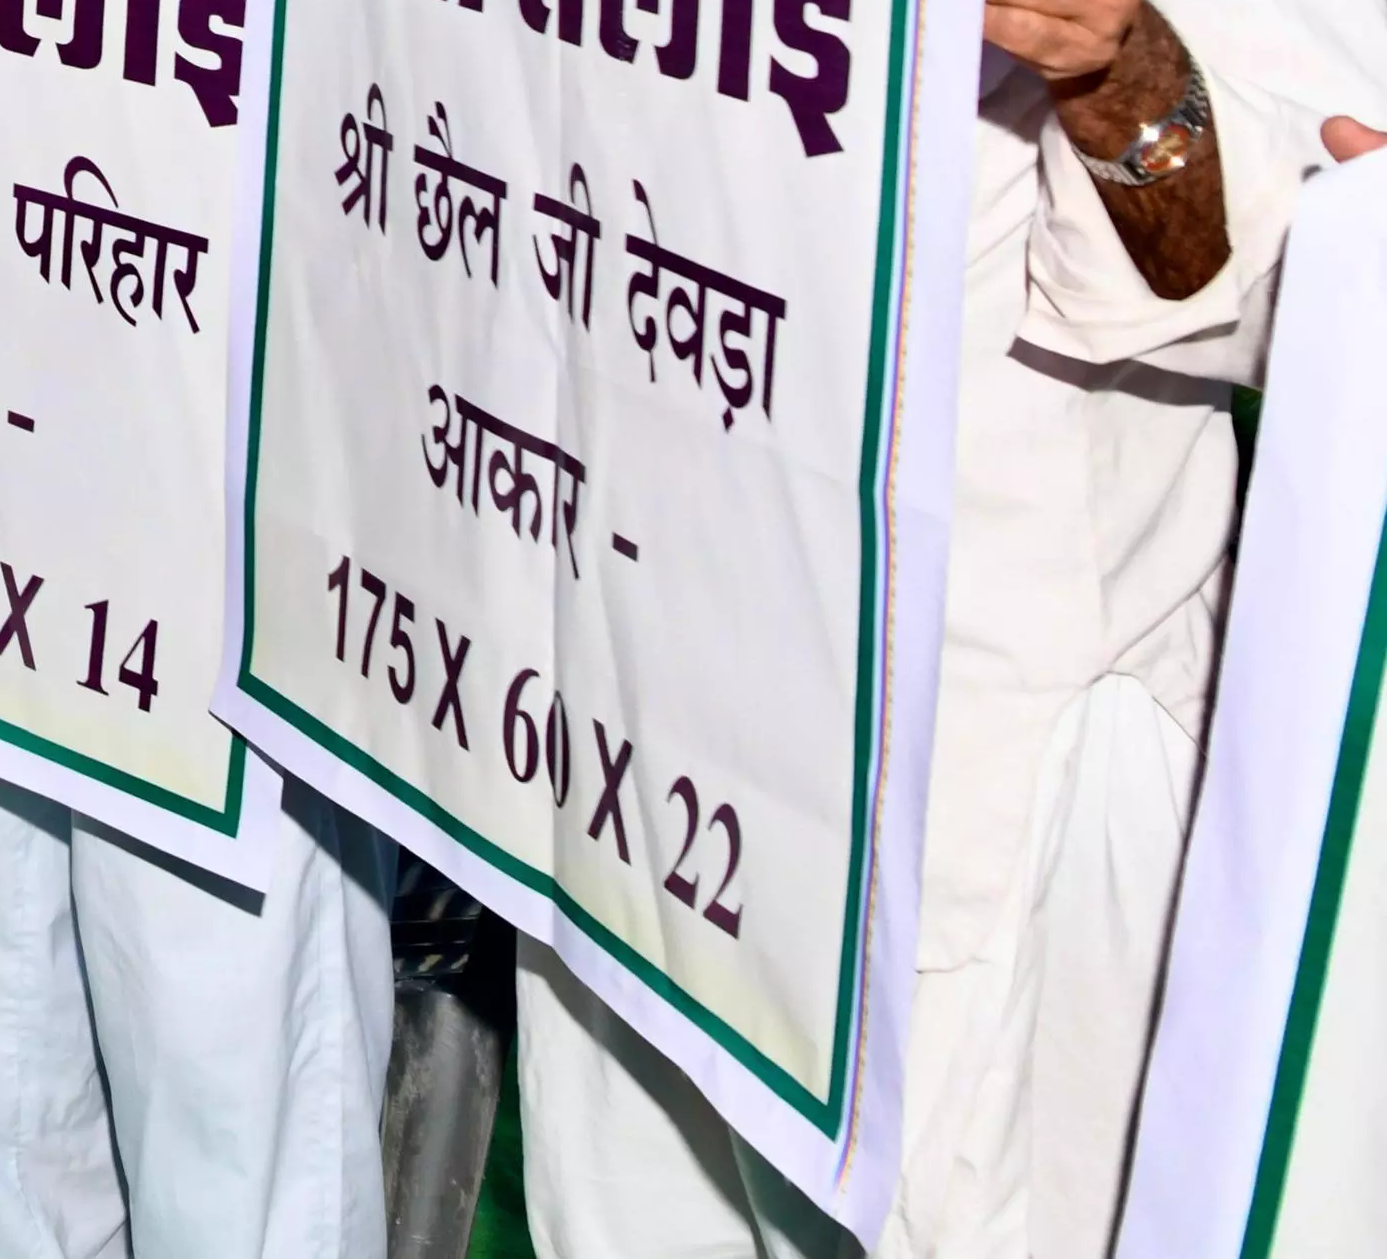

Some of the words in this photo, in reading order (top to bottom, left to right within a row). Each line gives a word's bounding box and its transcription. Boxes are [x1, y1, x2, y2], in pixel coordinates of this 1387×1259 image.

[14, 156, 209, 334] परिहार
[334, 83, 394, 234] श्री
[414, 101, 507, 287] छैल
[533, 163, 601, 332] जी
[625, 179, 787, 432] देवड़ा
[422, 384, 586, 579] आकार
[77, 600, 159, 712] 14
[328, 555, 416, 704] 175
[432, 619, 471, 750] X
[503, 668, 571, 808] 60
[587, 720, 633, 864] X
[664, 776, 743, 939] 22
